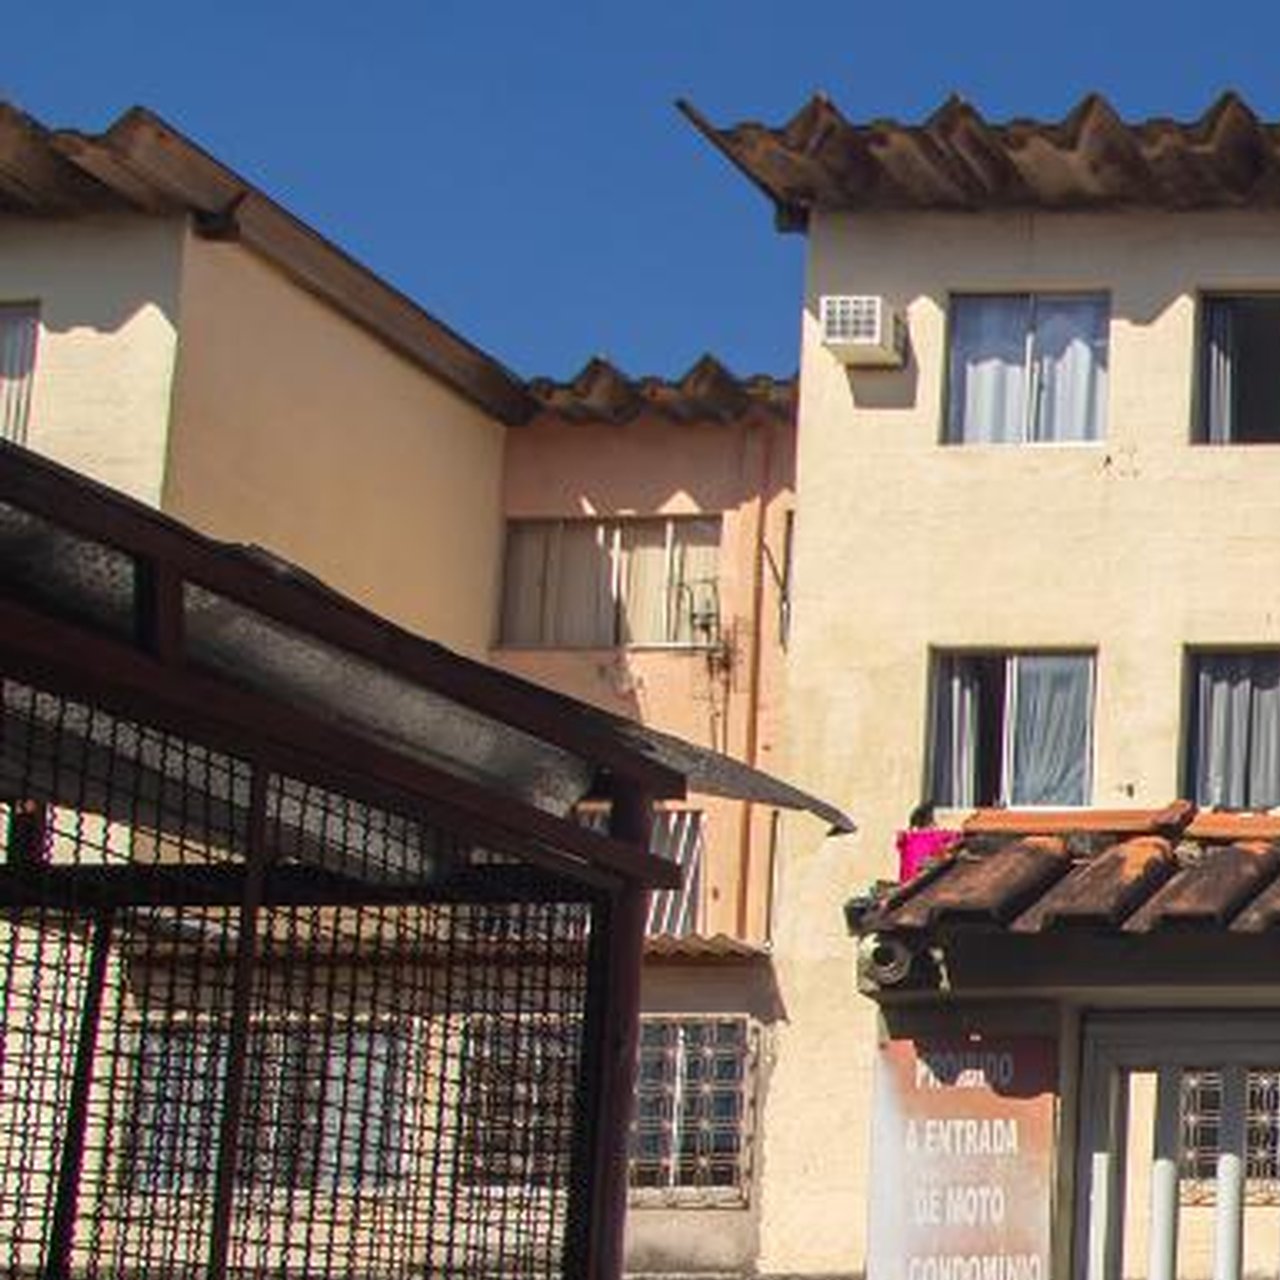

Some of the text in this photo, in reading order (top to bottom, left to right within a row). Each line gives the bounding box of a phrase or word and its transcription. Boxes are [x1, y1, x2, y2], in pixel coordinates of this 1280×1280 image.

[905, 1119, 1018, 1155] A ENTRADA
[916, 1186, 1007, 1227] DE MOTO
